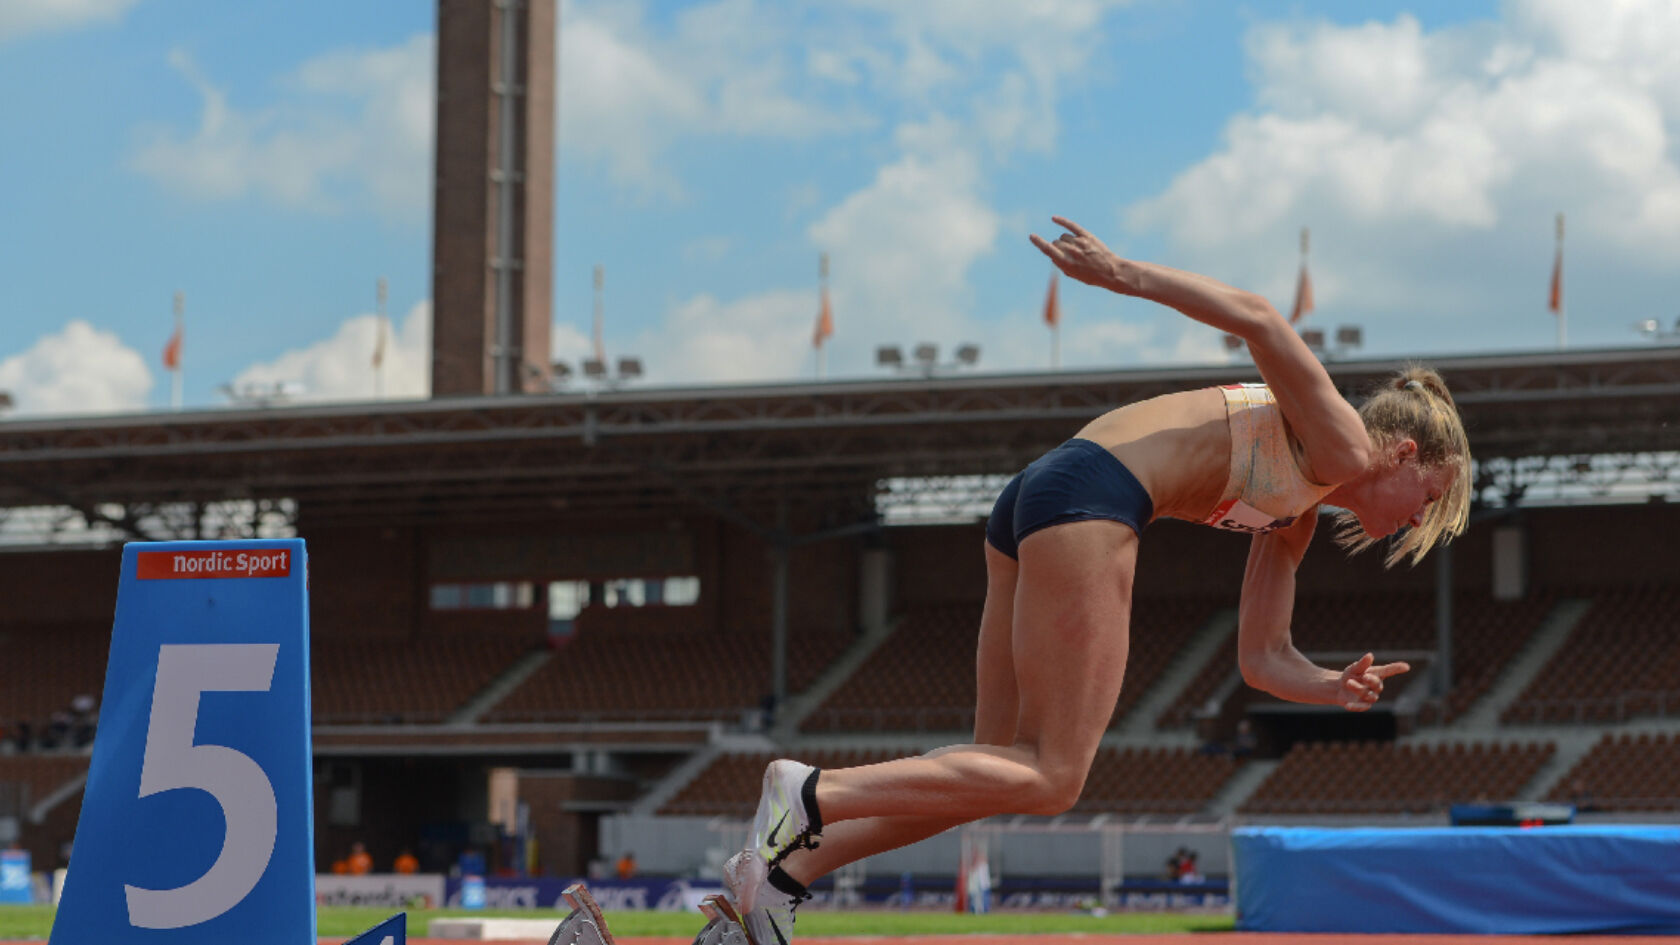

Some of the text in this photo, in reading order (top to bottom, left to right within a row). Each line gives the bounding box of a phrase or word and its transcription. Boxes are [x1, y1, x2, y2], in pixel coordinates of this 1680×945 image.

[173, 551, 288, 577] nordic Sport
[124, 643, 281, 930] 5
